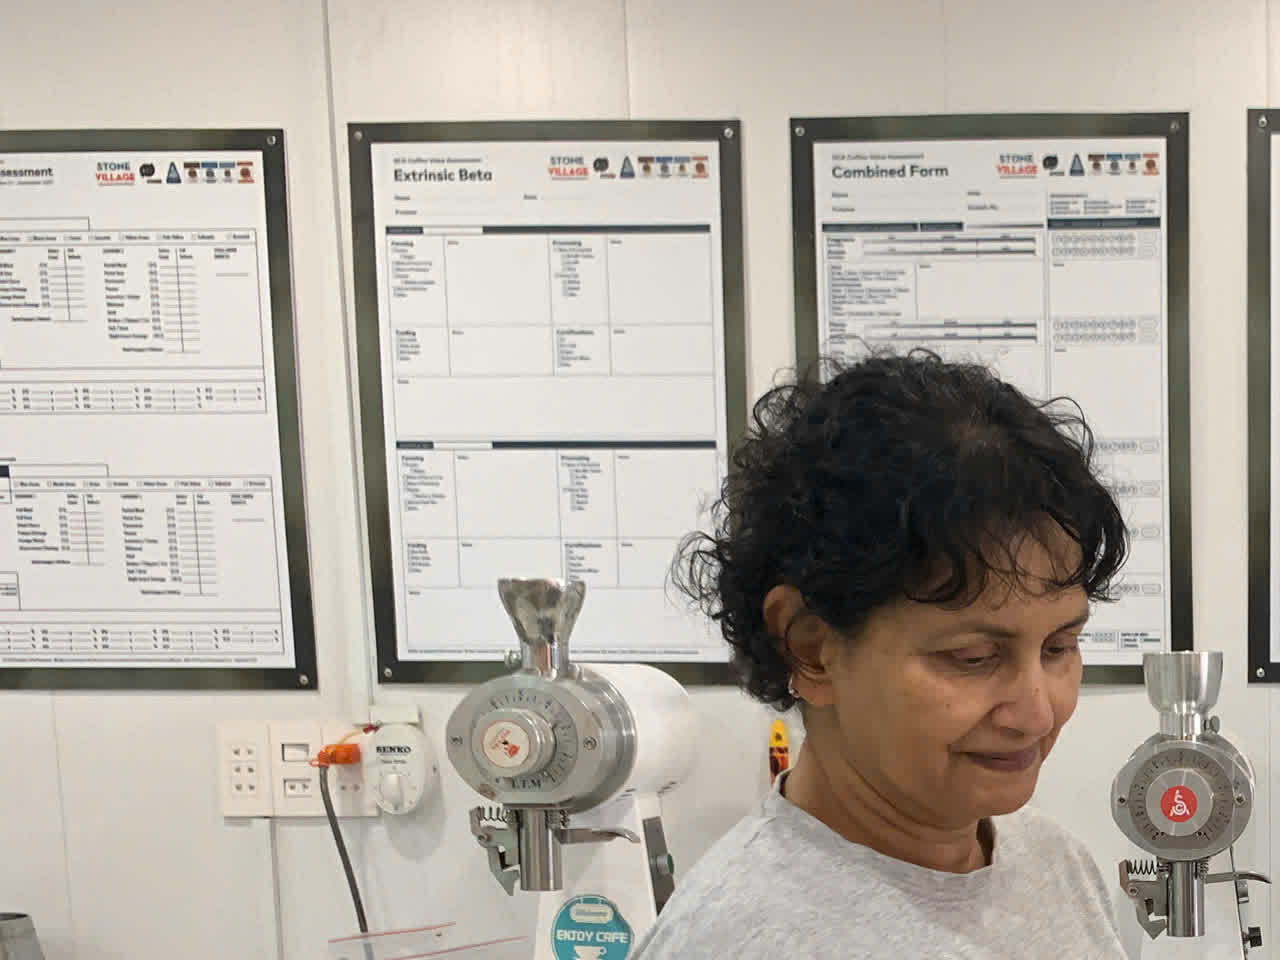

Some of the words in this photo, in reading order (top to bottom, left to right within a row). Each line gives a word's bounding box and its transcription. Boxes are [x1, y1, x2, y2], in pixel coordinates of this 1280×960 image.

[0, 168, 53, 177] sessment
[96, 172, 135, 181] VILLAGE
[394, 168, 455, 182] Extrinsic
[459, 168, 492, 181] Beta
[548, 167, 588, 176] VILLAGE
[832, 165, 906, 178] Combined
[910, 164, 949, 177] Form
[556, 929, 594, 942] ENJOY
[596, 931, 629, 944] CAFE
